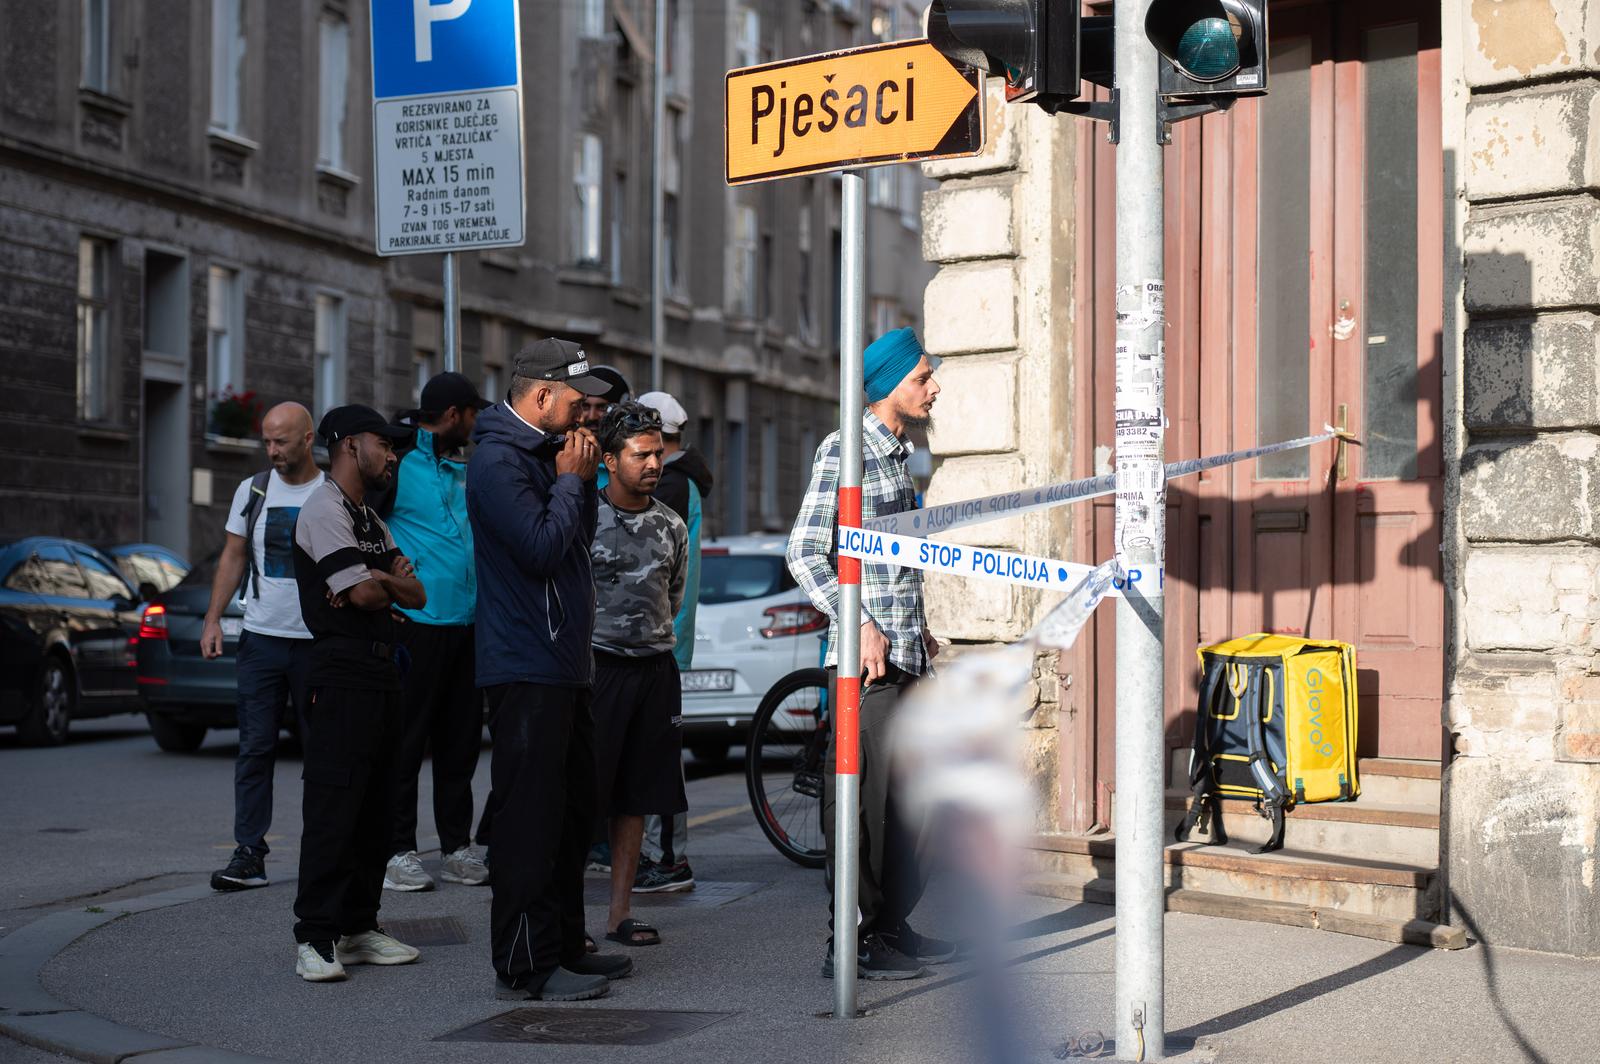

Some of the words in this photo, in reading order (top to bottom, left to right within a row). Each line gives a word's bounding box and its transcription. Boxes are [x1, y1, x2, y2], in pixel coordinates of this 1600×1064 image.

[402, 100, 472, 117] REZERVIRANO
[477, 98, 490, 111] ZA
[751, 61, 914, 157] Pješaci
[396, 117, 449, 133] KORISNIKE
[454, 112, 497, 129] DJEČJEG
[395, 133, 431, 149] VRTIĆA
[421, 151, 428, 163] 5
[434, 148, 474, 163] MJESTA
[402, 167, 435, 186] MAX
[443, 165, 459, 183] 15
[466, 163, 495, 181] min
[407, 187, 448, 201] Radnim
[453, 185, 490, 198] danom
[474, 198, 495, 212] sati
[401, 222, 427, 233] IZVAN
[432, 219, 449, 231] TOG
[454, 216, 497, 229] VREMENA
[389, 233, 441, 247] PARKIRANJE
[445, 232, 455, 243] SE
[458, 228, 510, 242] NAPLAĆUJE
[920, 543, 961, 569] STOP
[973, 551, 1049, 584] POLICIJA
[1306, 667, 1324, 746] Glovo
